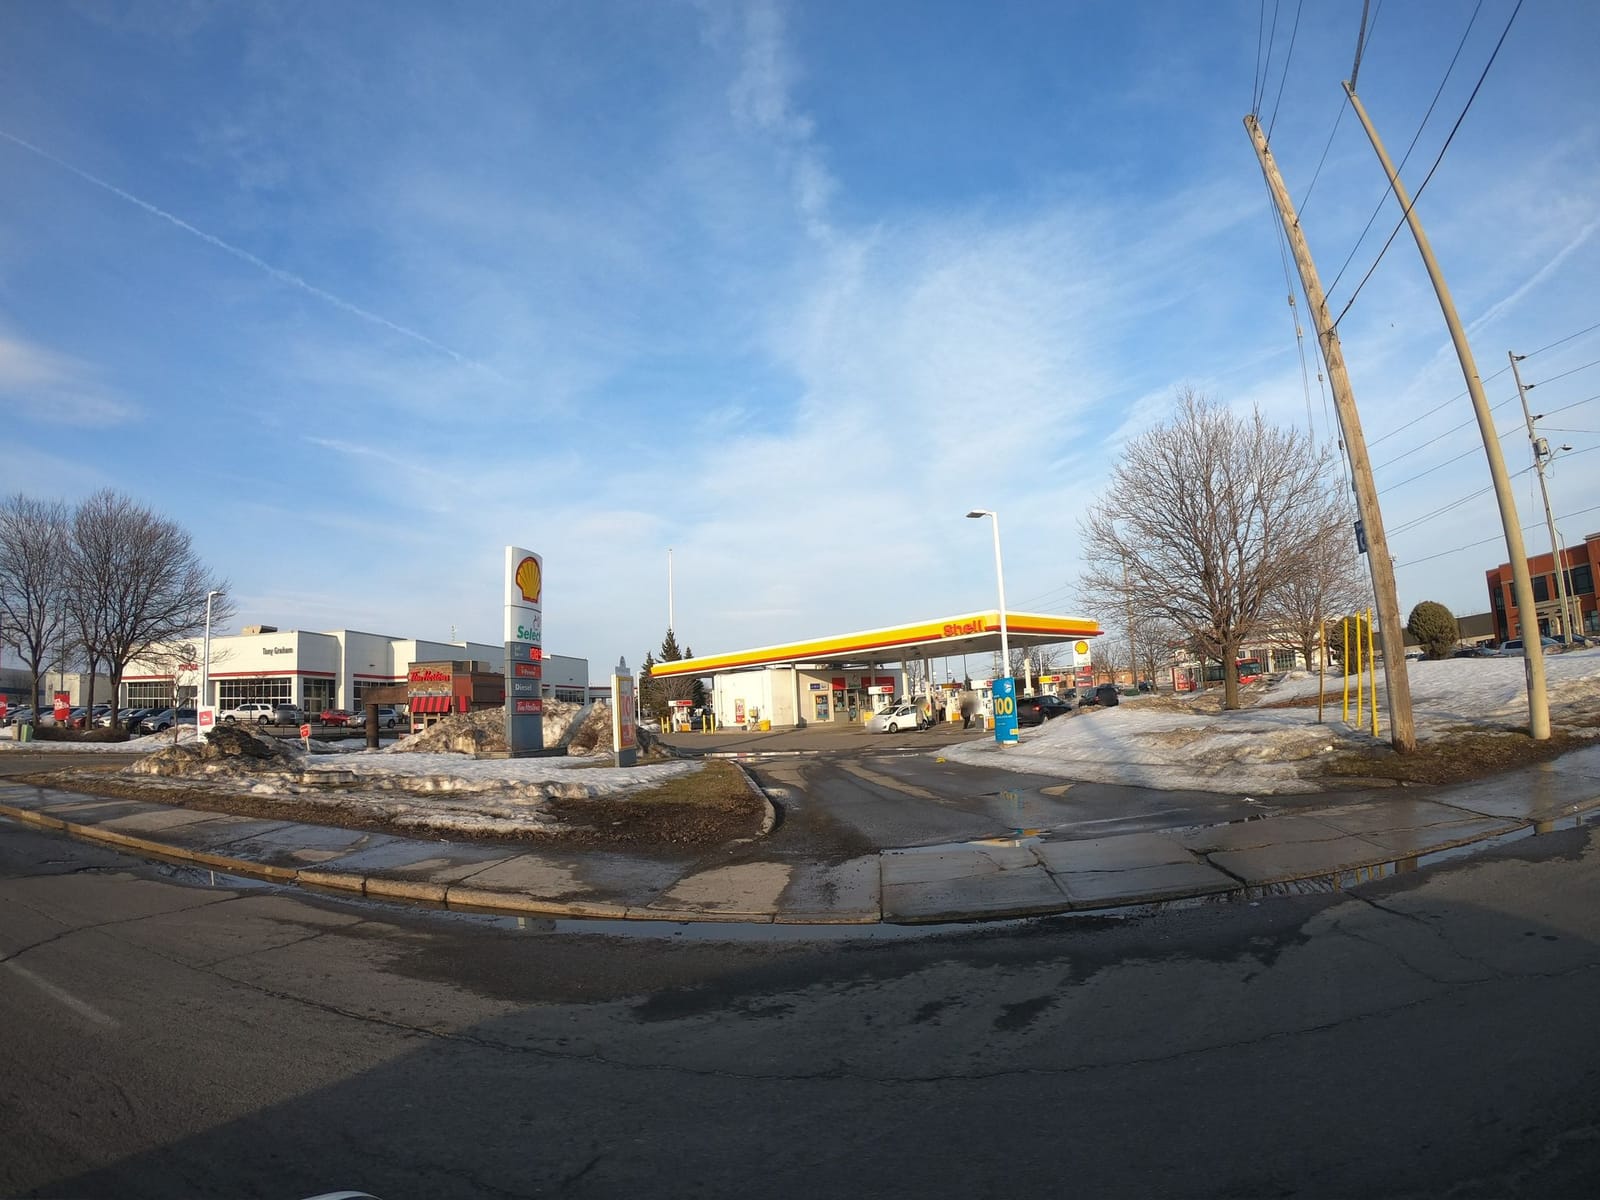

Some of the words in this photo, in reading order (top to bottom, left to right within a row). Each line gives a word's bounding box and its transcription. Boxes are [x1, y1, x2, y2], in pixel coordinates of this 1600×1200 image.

[943, 619, 982, 637] Shell
[263, 648, 273, 656] Tony
[274, 647, 293, 655] Graham
[178, 663, 199, 671] TOYOTA
[410, 671, 423, 682] Tim
[424, 670, 450, 682] Hortons
[515, 683, 532, 691] Diesel
[994, 696, 1013, 715] 100
